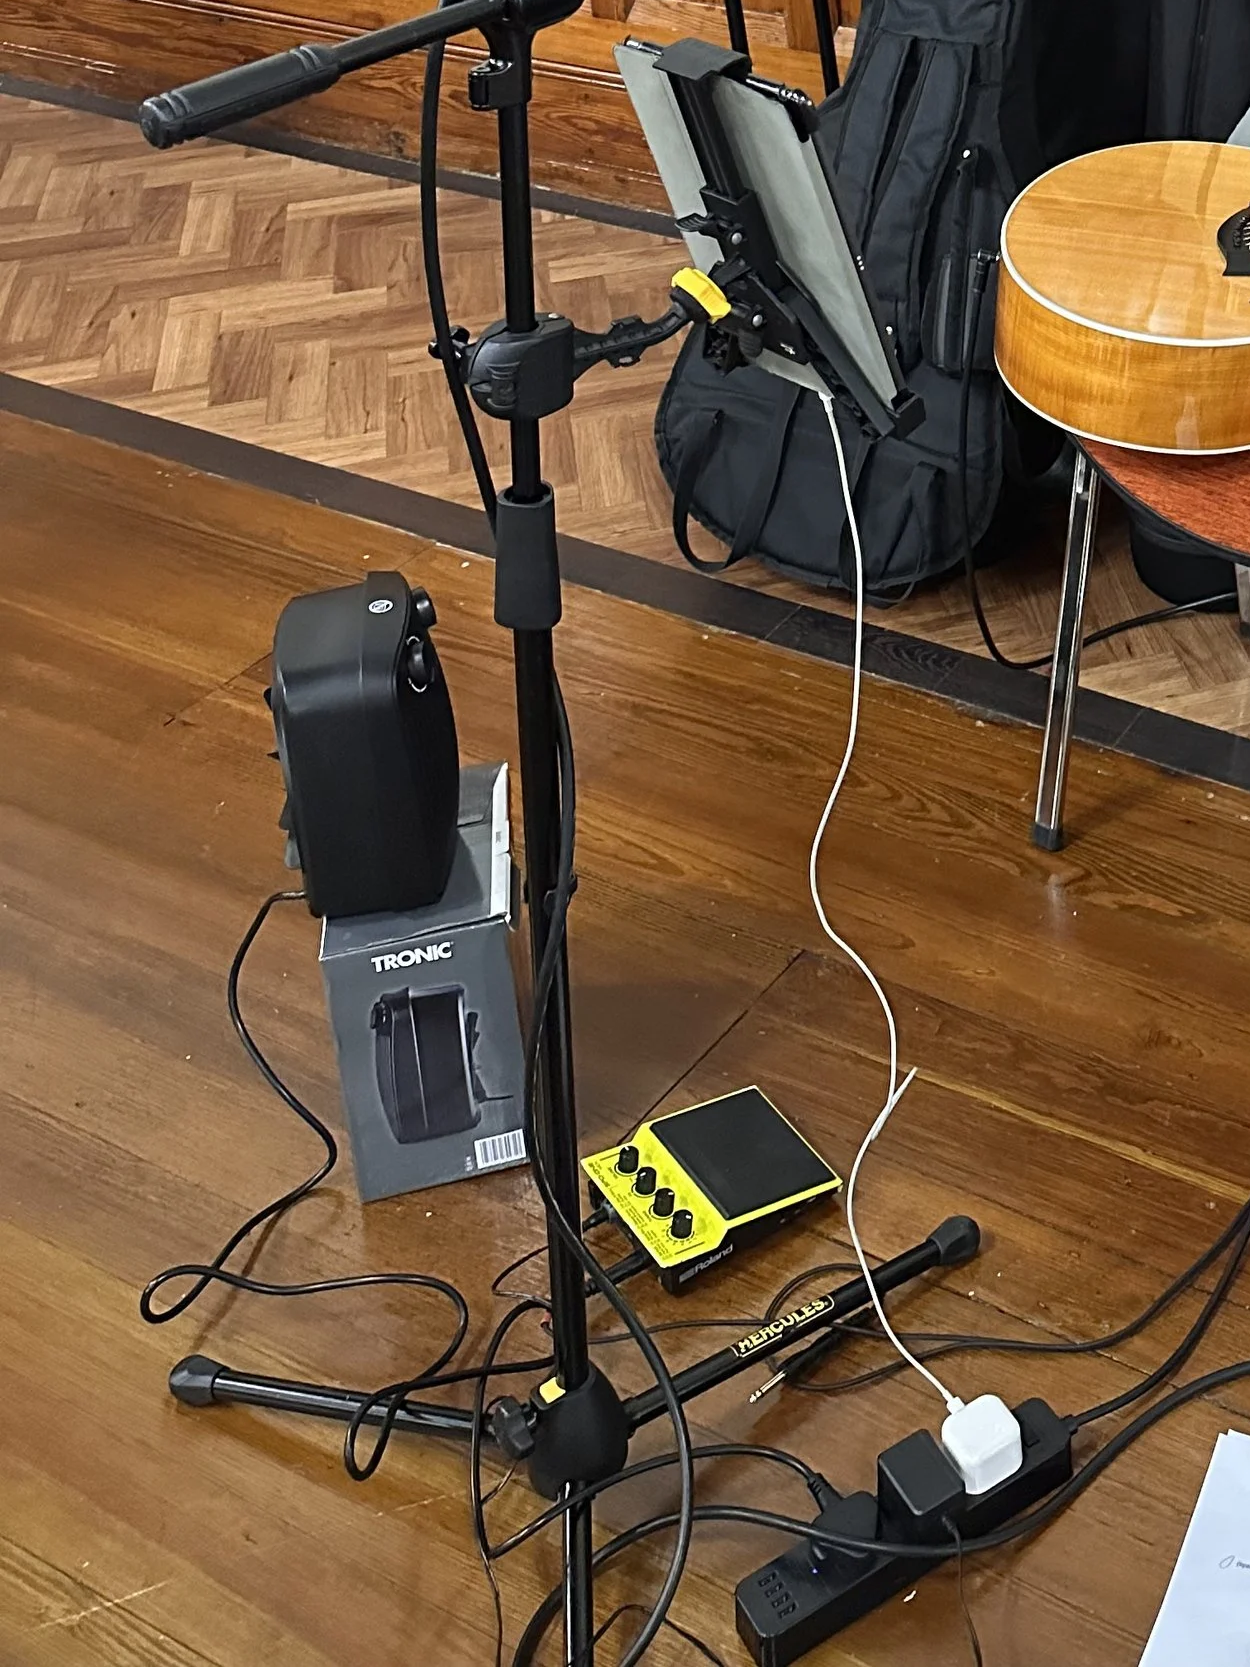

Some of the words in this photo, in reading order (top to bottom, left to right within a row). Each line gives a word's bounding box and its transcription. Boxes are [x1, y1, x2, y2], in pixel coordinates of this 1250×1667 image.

[370, 941, 453, 973] TRONIC
[693, 1243, 734, 1273] Roland
[738, 1298, 827, 1354] HERCULES
